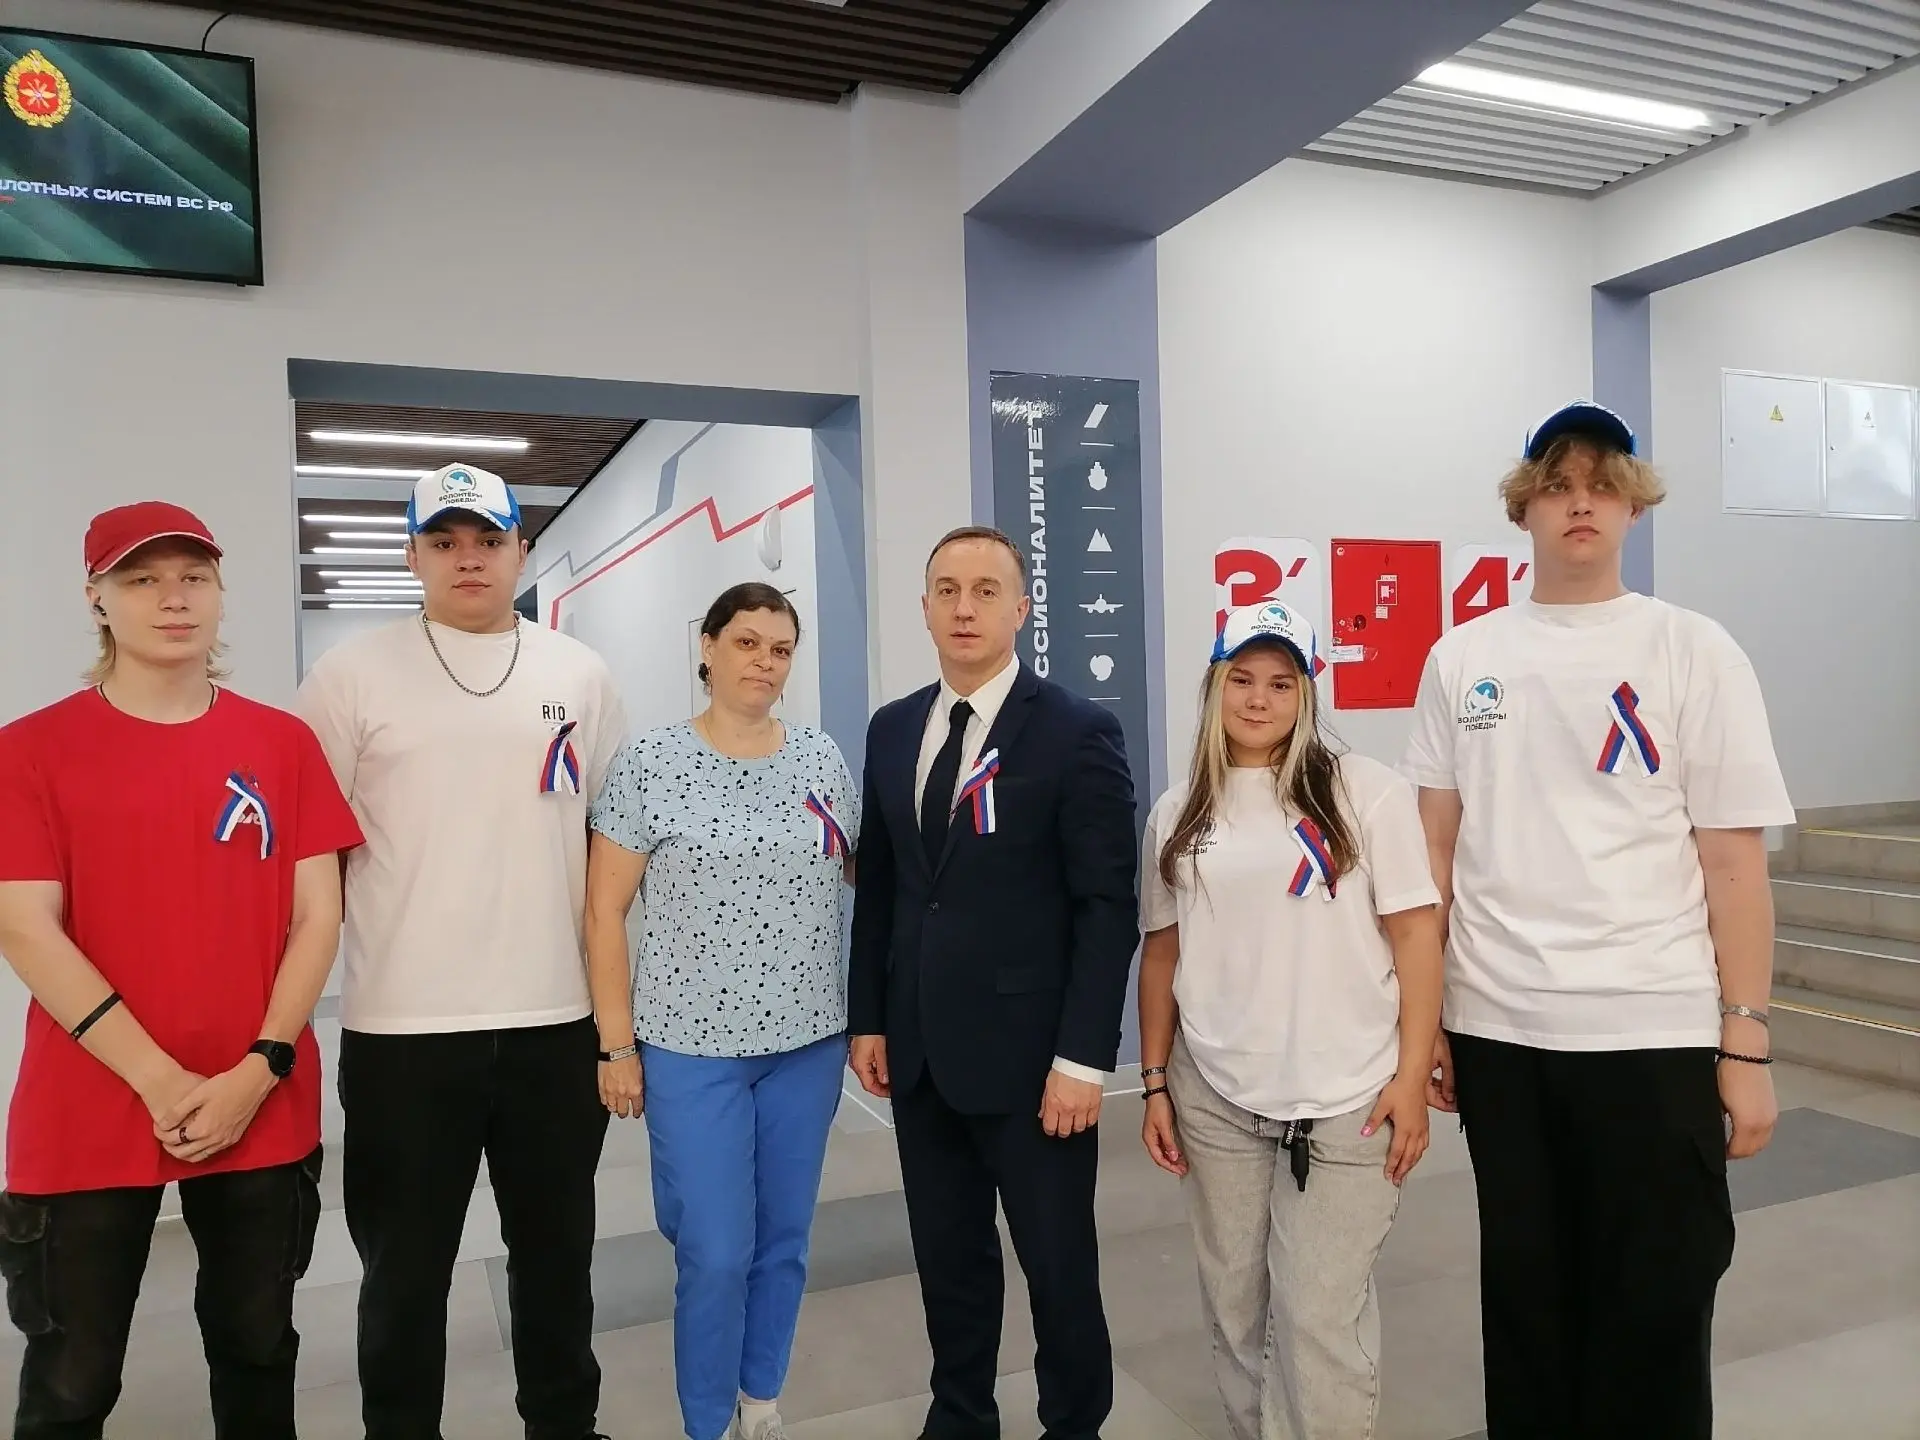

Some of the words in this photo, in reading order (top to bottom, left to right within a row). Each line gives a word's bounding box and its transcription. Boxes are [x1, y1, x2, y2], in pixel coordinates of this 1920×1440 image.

[0, 180, 89, 198] ЛОТНЫХ
[93, 188, 172, 207] СИСТЕМ
[177, 196, 204, 210] ВС
[208, 200, 233, 212] РФ
[542, 704, 566, 721] RIO
